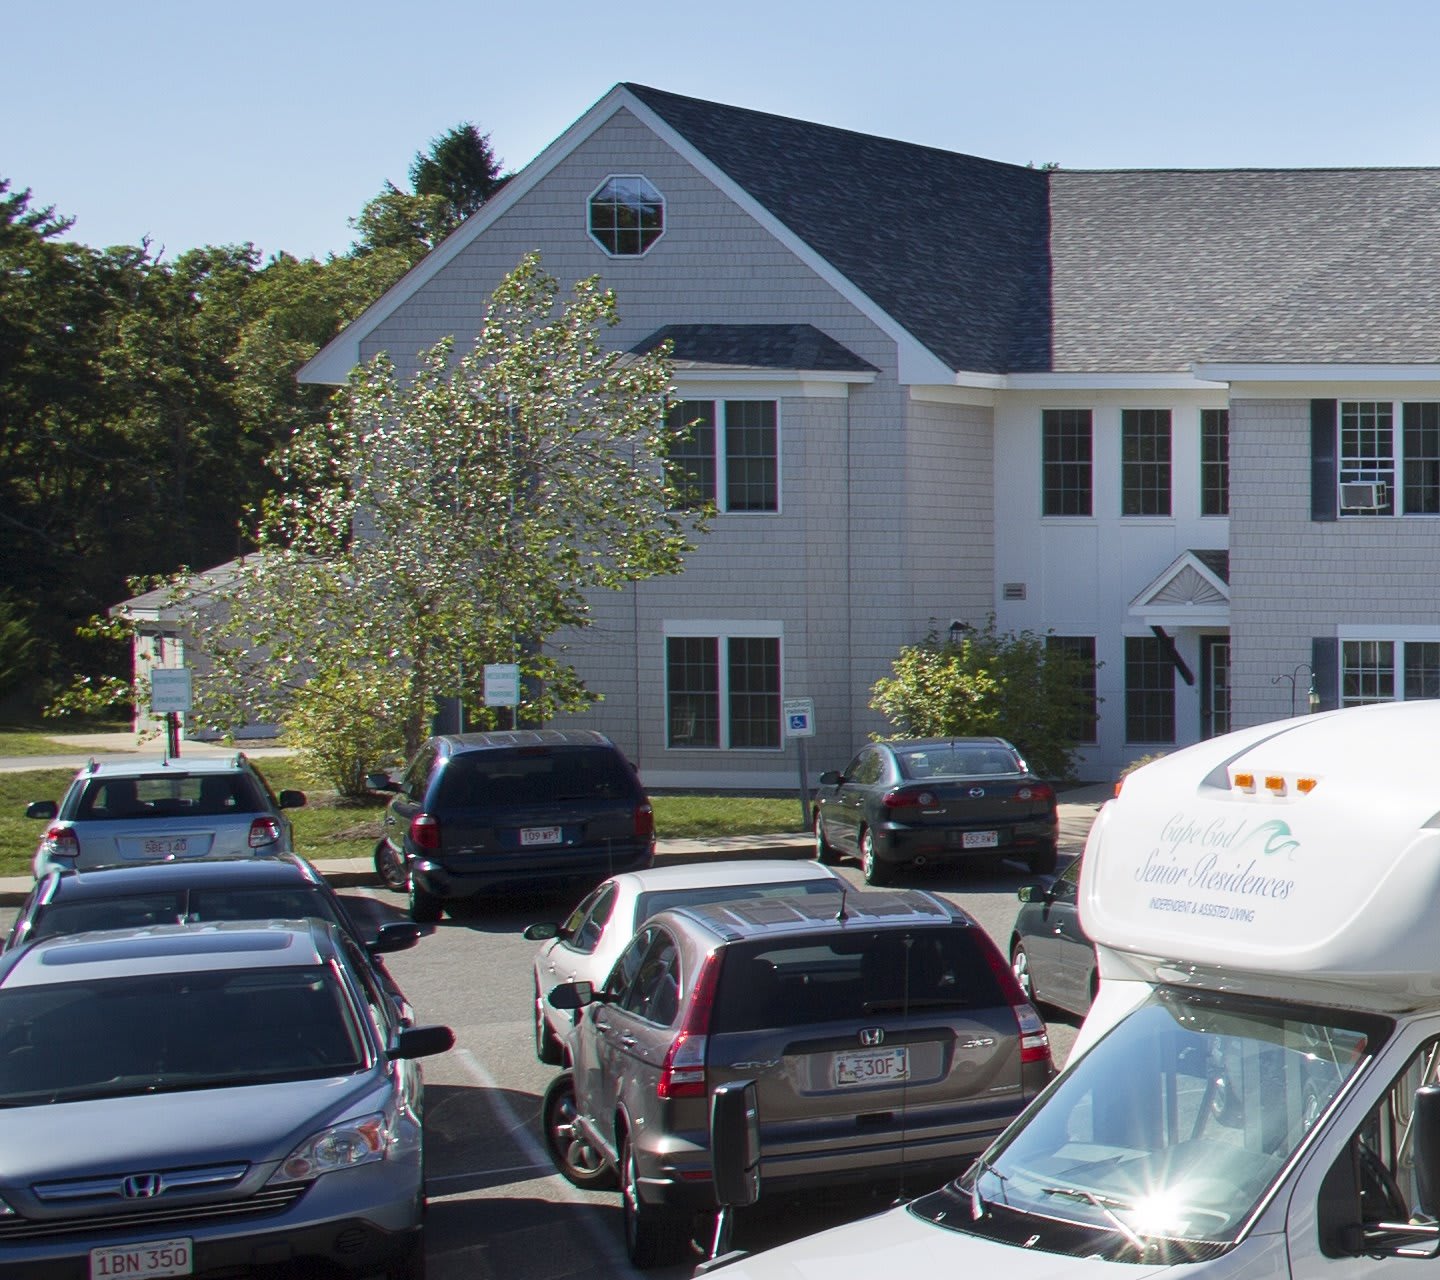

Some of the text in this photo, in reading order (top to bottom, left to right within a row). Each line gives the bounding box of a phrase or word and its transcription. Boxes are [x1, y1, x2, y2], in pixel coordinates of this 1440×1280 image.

[1161, 812, 1248, 854] Cape Cod
[1134, 848, 1295, 900] Senior Residences
[1149, 896, 1192, 914] INDEPENDENT
[1199, 903, 1230, 918] ASSISTED
[1230, 909, 1256, 923] LIVING
[97, 1253, 140, 1276] 1BN
[146, 1248, 188, 1270] 350
